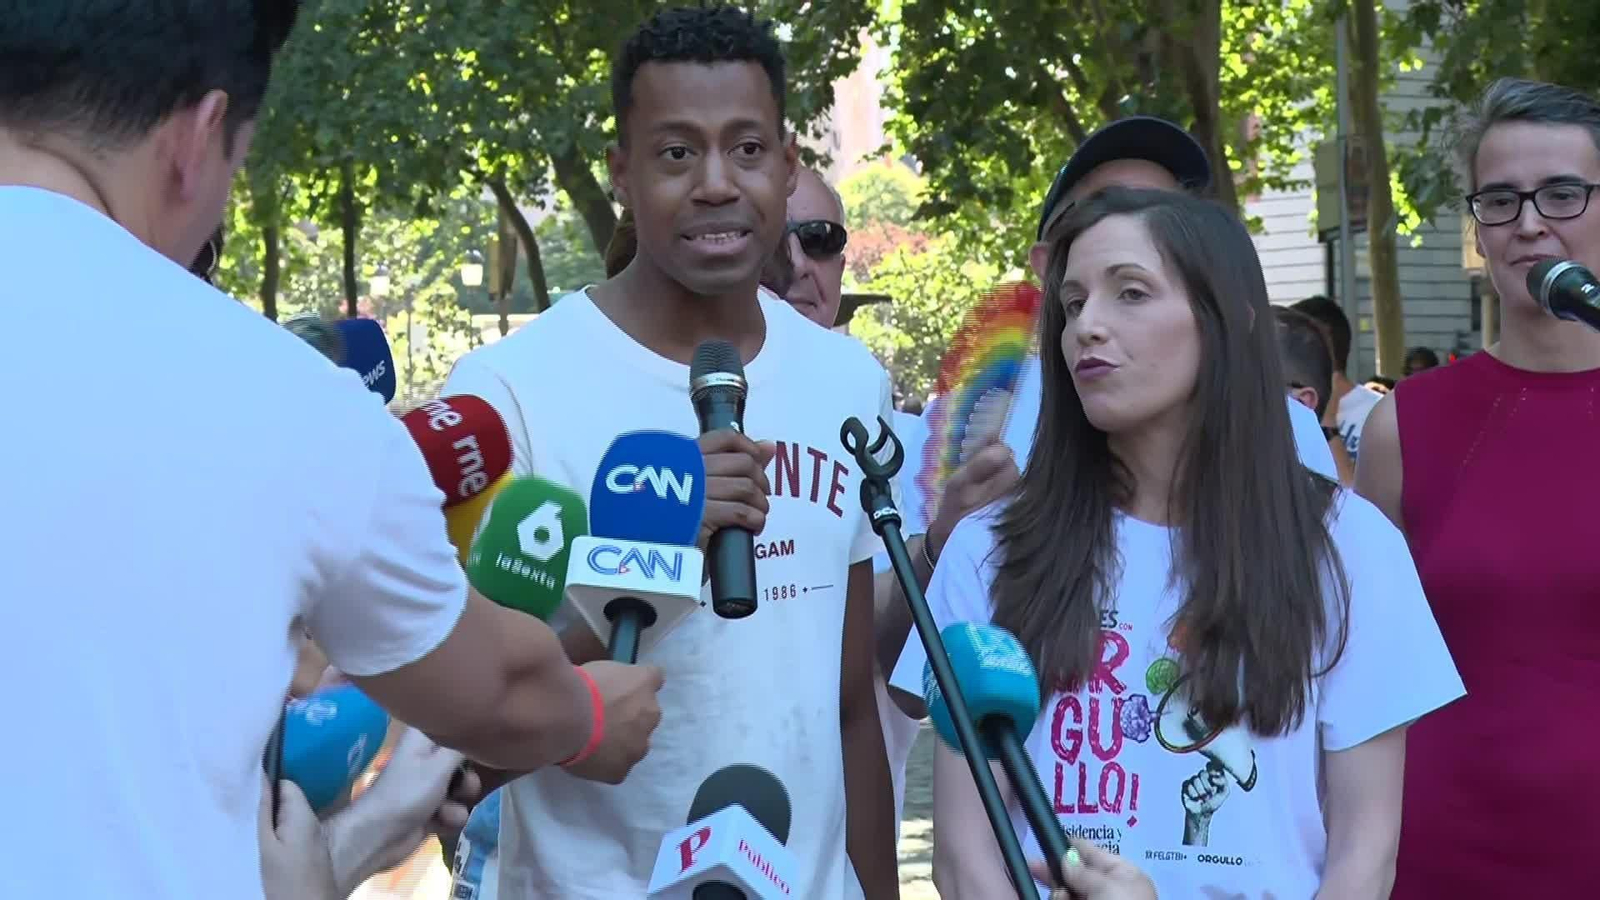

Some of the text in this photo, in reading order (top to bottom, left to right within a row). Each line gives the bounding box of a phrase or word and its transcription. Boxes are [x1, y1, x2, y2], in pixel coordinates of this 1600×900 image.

[453, 434, 488, 496] rne
[606, 463, 693, 506] CAN
[765, 440, 849, 518] NTE
[587, 544, 683, 582] CAN
[755, 539, 795, 559] GAM
[764, 584, 797, 601] 1986
[1051, 694, 1124, 765] GU
[1053, 761, 1139, 828] LLO!
[677, 826, 712, 874] P
[1197, 853, 1243, 866] ORGULLO
